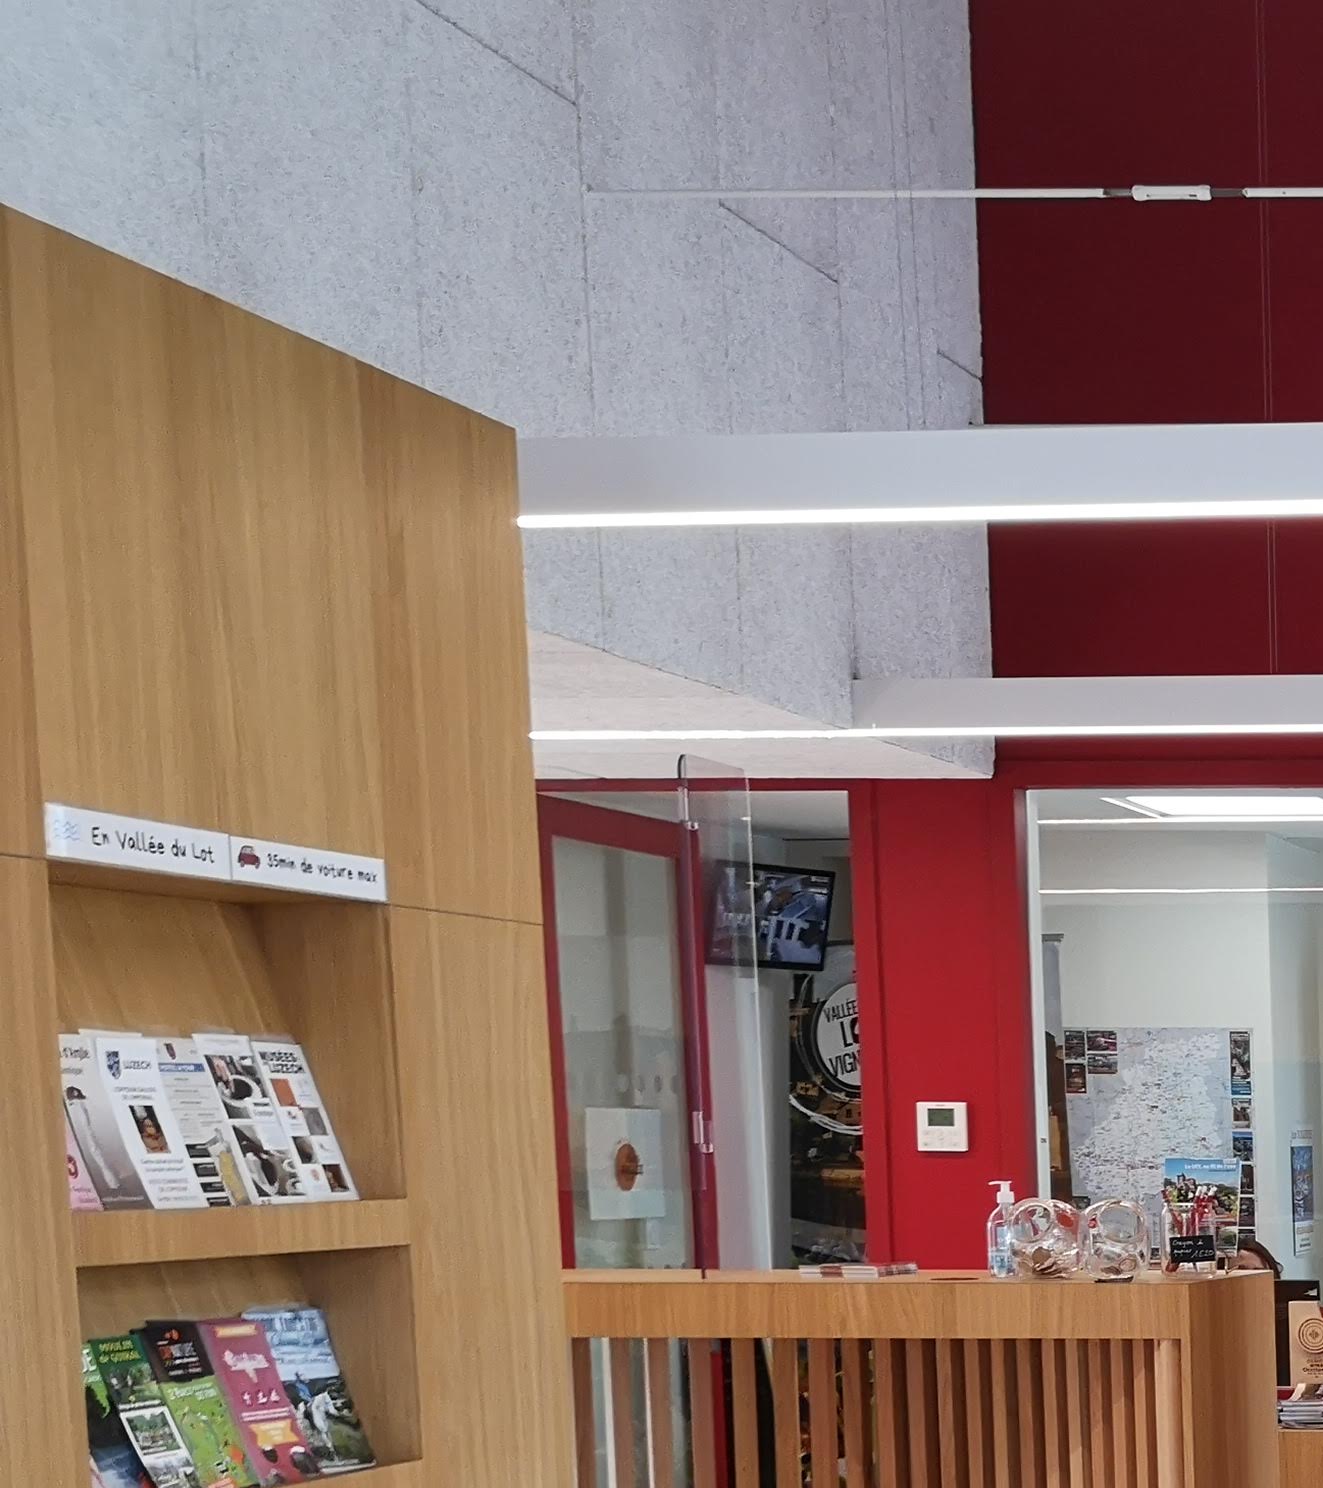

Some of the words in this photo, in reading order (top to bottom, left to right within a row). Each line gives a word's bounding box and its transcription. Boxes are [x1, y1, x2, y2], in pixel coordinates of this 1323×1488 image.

[91, 826, 111, 848] En
[115, 829, 167, 857] Vallée
[171, 837, 188, 859] du
[191, 841, 216, 866] Lot
[300, 856, 314, 876] de
[316, 859, 355, 883] voiture
[356, 867, 378, 886] max
